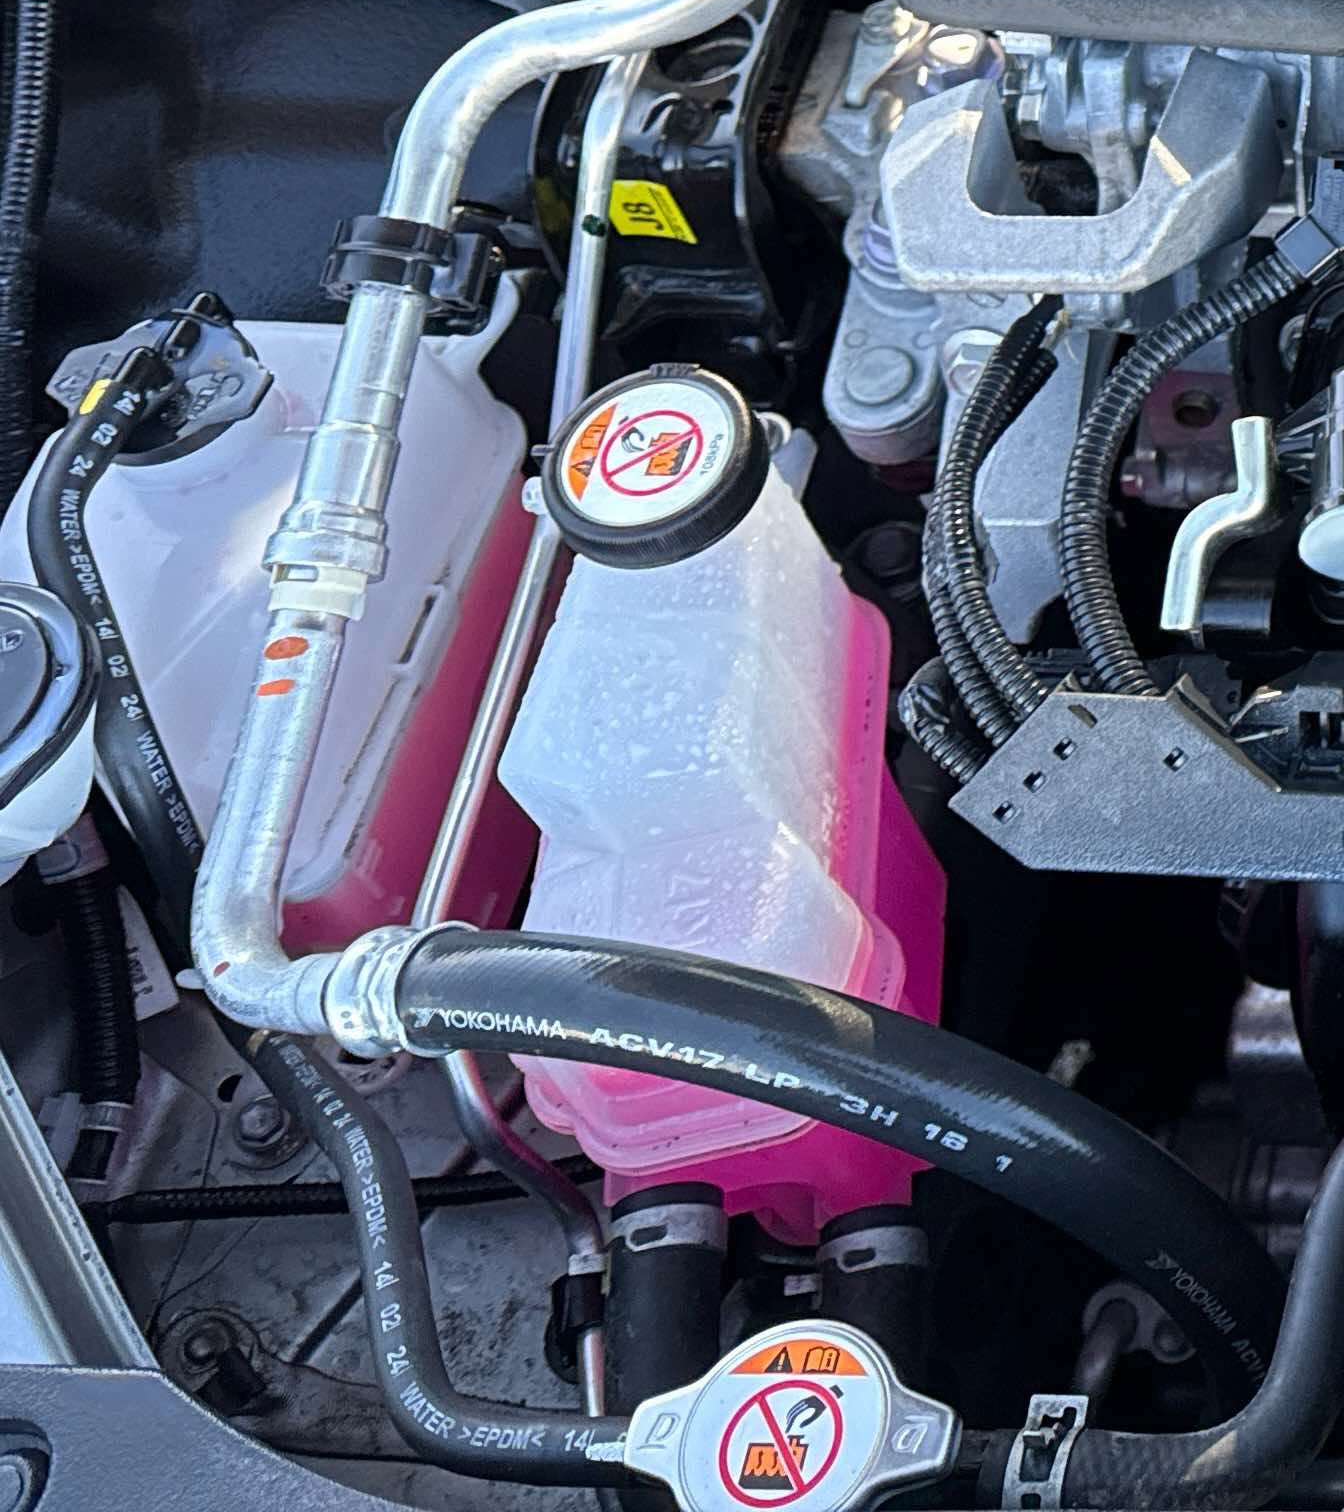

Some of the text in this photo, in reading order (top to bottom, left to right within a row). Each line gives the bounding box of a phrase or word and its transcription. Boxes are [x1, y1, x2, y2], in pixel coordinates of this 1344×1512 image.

[621, 201, 665, 231] J8
[59, 488, 82, 541] WATER
[136, 730, 173, 795] WATER
[441, 1008, 568, 1041] YOKOHAMA
[344, 1125, 375, 1175] WATER
[399, 1381, 457, 1440] WATER
[1169, 1267, 1238, 1336] YOKOHAMA
